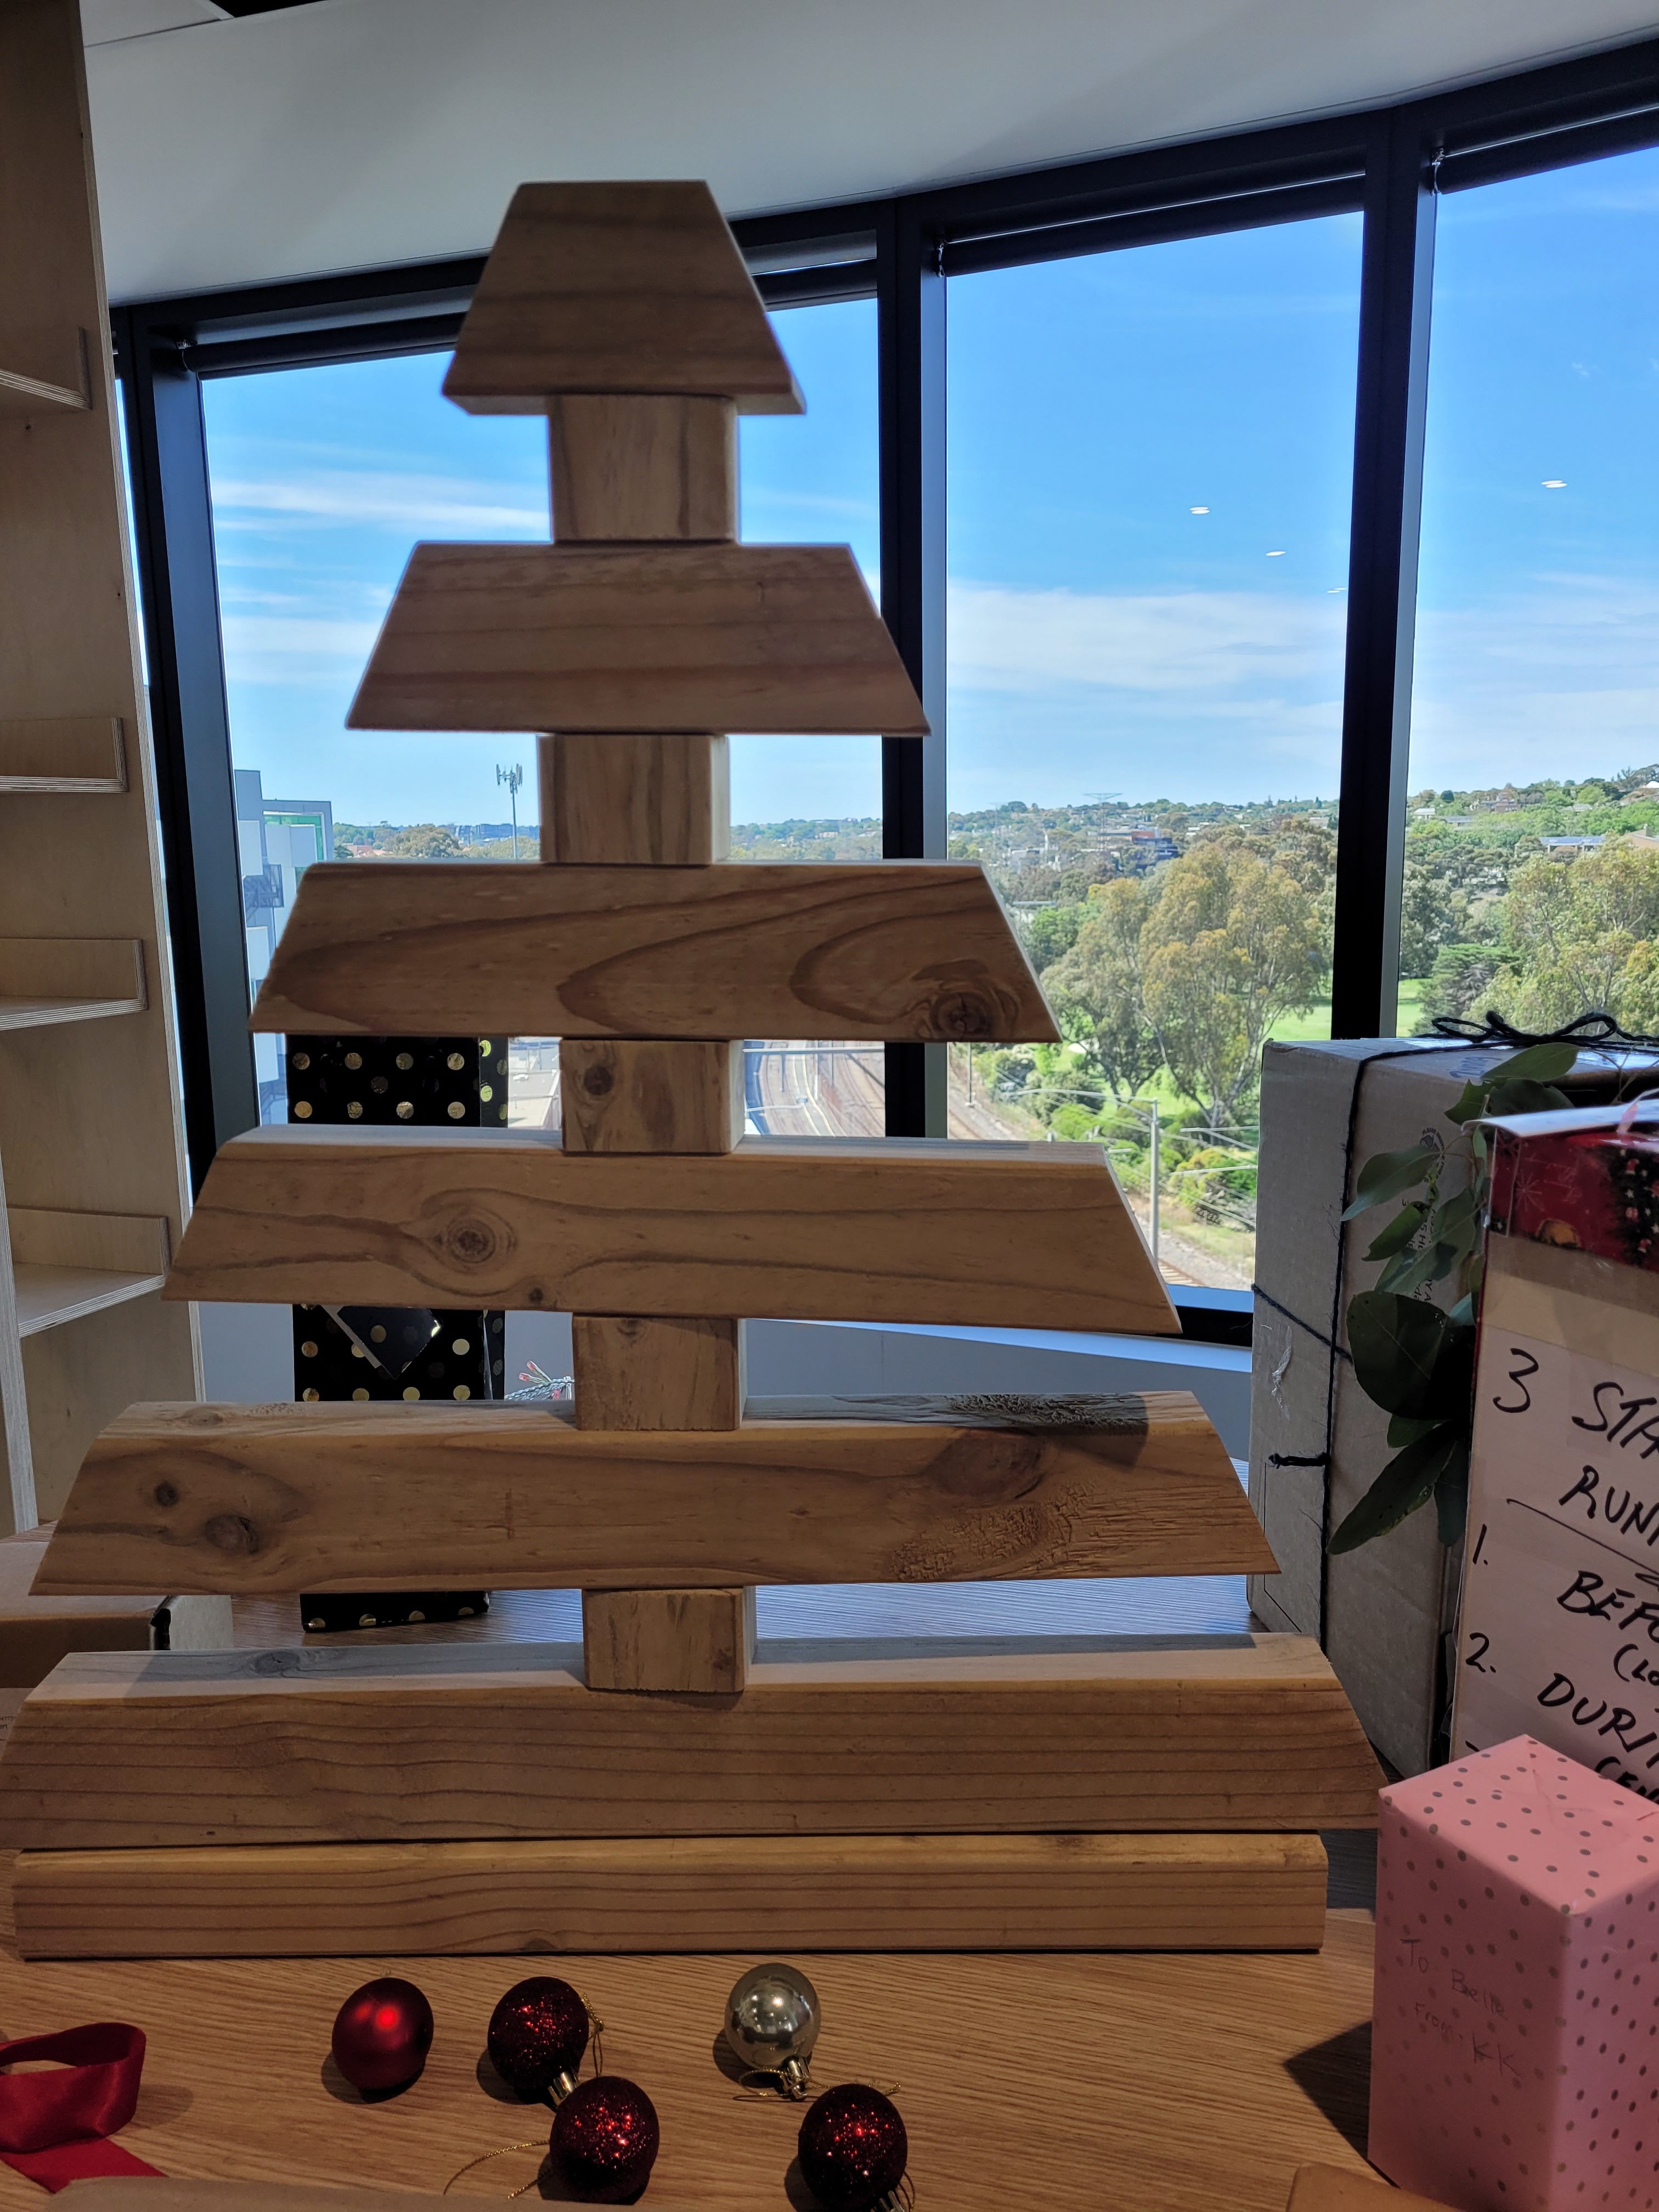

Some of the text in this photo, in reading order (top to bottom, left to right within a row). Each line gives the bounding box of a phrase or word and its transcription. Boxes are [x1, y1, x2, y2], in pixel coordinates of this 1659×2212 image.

[1492, 1347, 1659, 1459] 3 STA
[1472, 1523, 1488, 1565] 1.
[1465, 1632, 1659, 1769] 2. DURI
[1452, 1968, 1509, 2021] Belle
